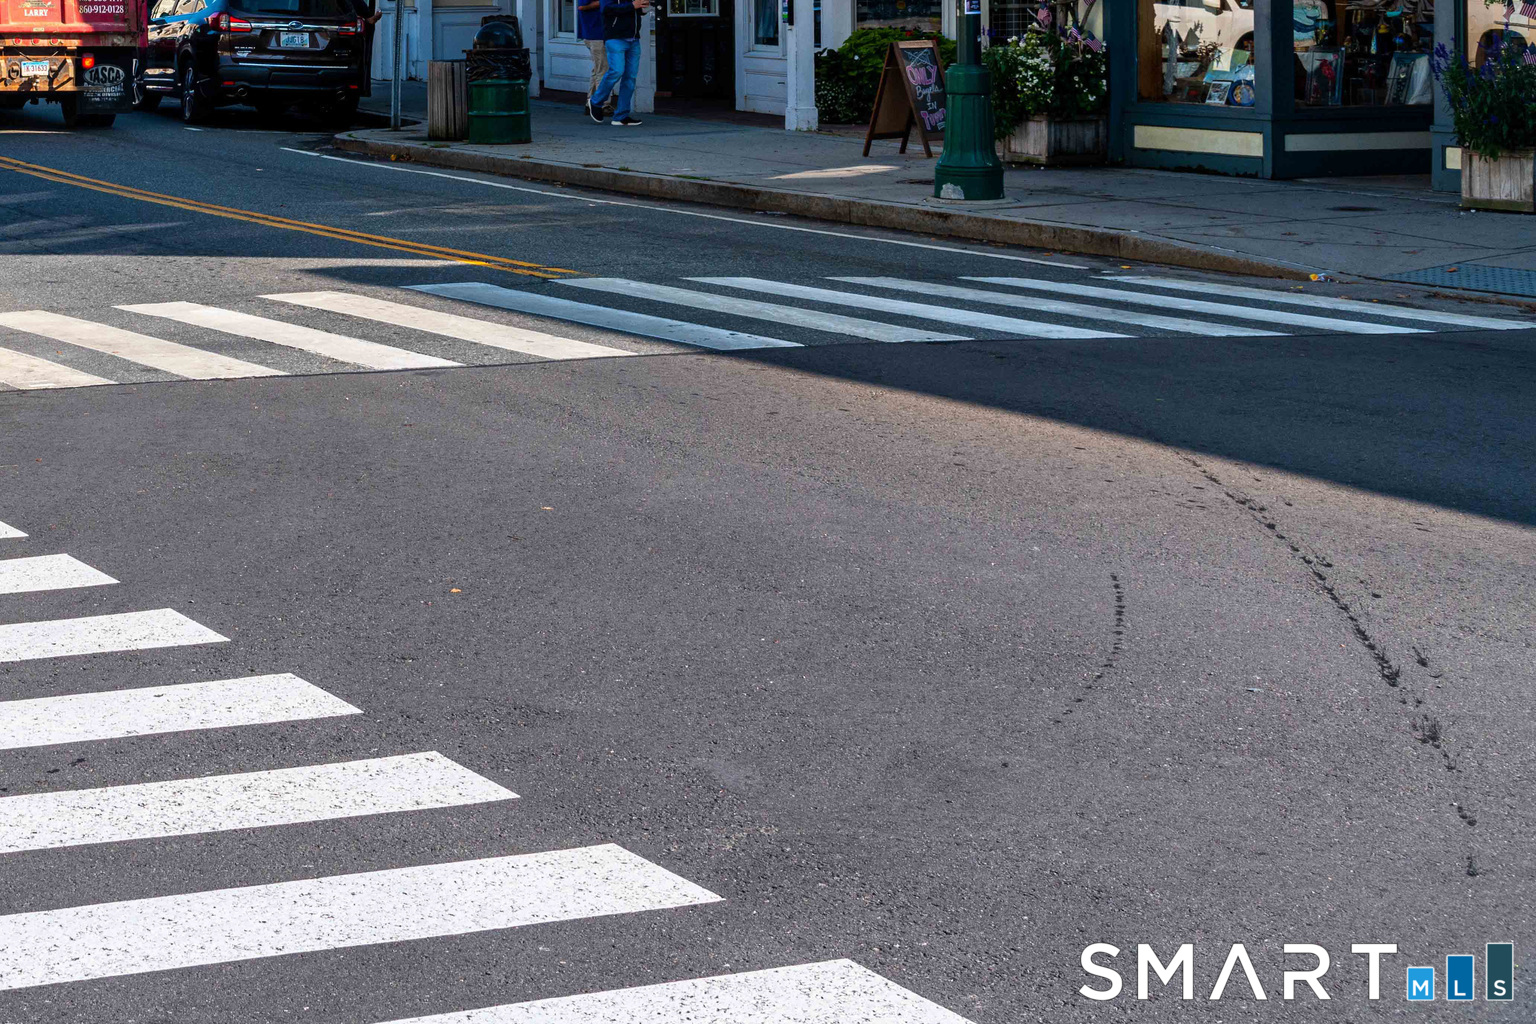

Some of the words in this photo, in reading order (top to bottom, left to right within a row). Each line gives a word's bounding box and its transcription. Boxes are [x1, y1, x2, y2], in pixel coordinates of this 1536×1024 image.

[24, 9, 49, 17] LARRY
[79, 5, 125, 14] 860-912-0128
[89, 67, 121, 83] TASCA
[905, 65, 937, 85] ONLY
